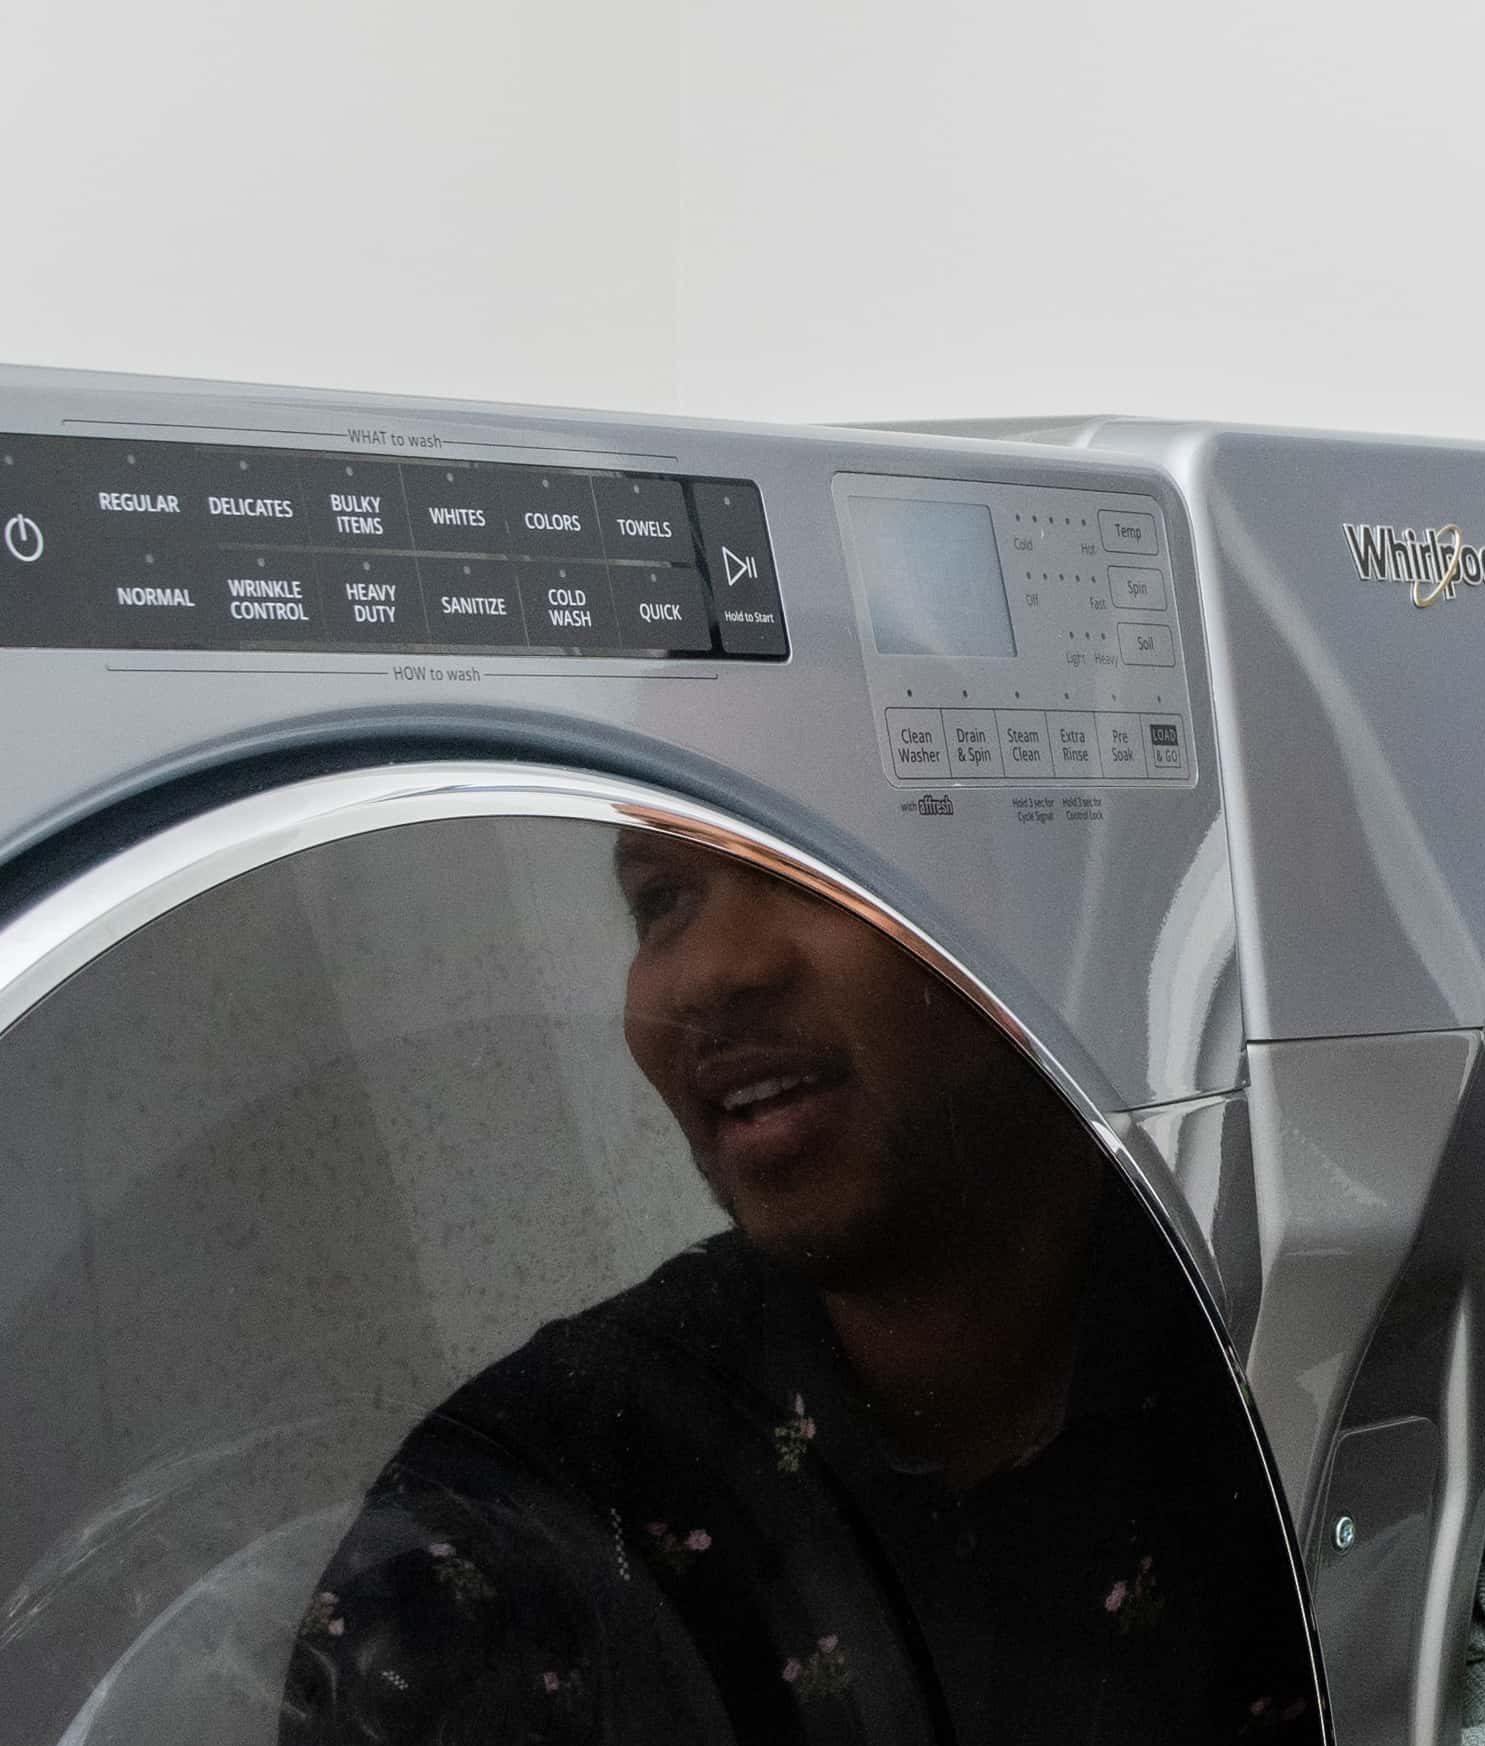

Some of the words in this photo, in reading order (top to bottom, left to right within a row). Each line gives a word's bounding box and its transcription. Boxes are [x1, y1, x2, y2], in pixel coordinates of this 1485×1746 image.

[348, 429, 387, 445] WHAT
[391, 432, 404, 446] to
[408, 433, 442, 448] wash
[98, 492, 180, 513] REGULAR
[208, 496, 293, 518] DELICATES
[330, 494, 380, 513] BULKY
[337, 516, 383, 534] ITEMS
[429, 508, 486, 526] WHITES
[525, 512, 581, 532] COLORS
[616, 518, 672, 538] TOWELS
[1114, 523, 1141, 543] Temp
[117, 587, 195, 607] NORMAL
[227, 579, 302, 598] WRINKLE
[346, 584, 396, 602] HEAVY
[548, 589, 586, 606] COLD
[1128, 581, 1148, 597] Spin
[230, 602, 309, 621] CONTROL
[354, 605, 396, 623] DUTY
[441, 596, 507, 615] SANITIZE
[639, 603, 682, 621] QUICK
[548, 609, 592, 627] WASH
[724, 610, 744, 622] Hold
[744, 612, 754, 622] to
[754, 611, 775, 624] Start
[1137, 636, 1154, 650] Soil
[393, 666, 425, 681] HOW
[430, 667, 443, 681] to
[446, 667, 480, 681] wash
[901, 728, 932, 744] Clean
[956, 728, 986, 743] Drain
[1007, 728, 1039, 743] Steam
[1060, 728, 1086, 743] Extra
[1112, 729, 1129, 744] Pre
[898, 748, 940, 763] Washer
[958, 748, 967, 762] &
[969, 747, 991, 767] Spin
[1013, 747, 1041, 762] Clean
[1063, 747, 1089, 762] Rinse
[1111, 748, 1134, 762] Soak
[1165, 751, 1178, 762] GO
